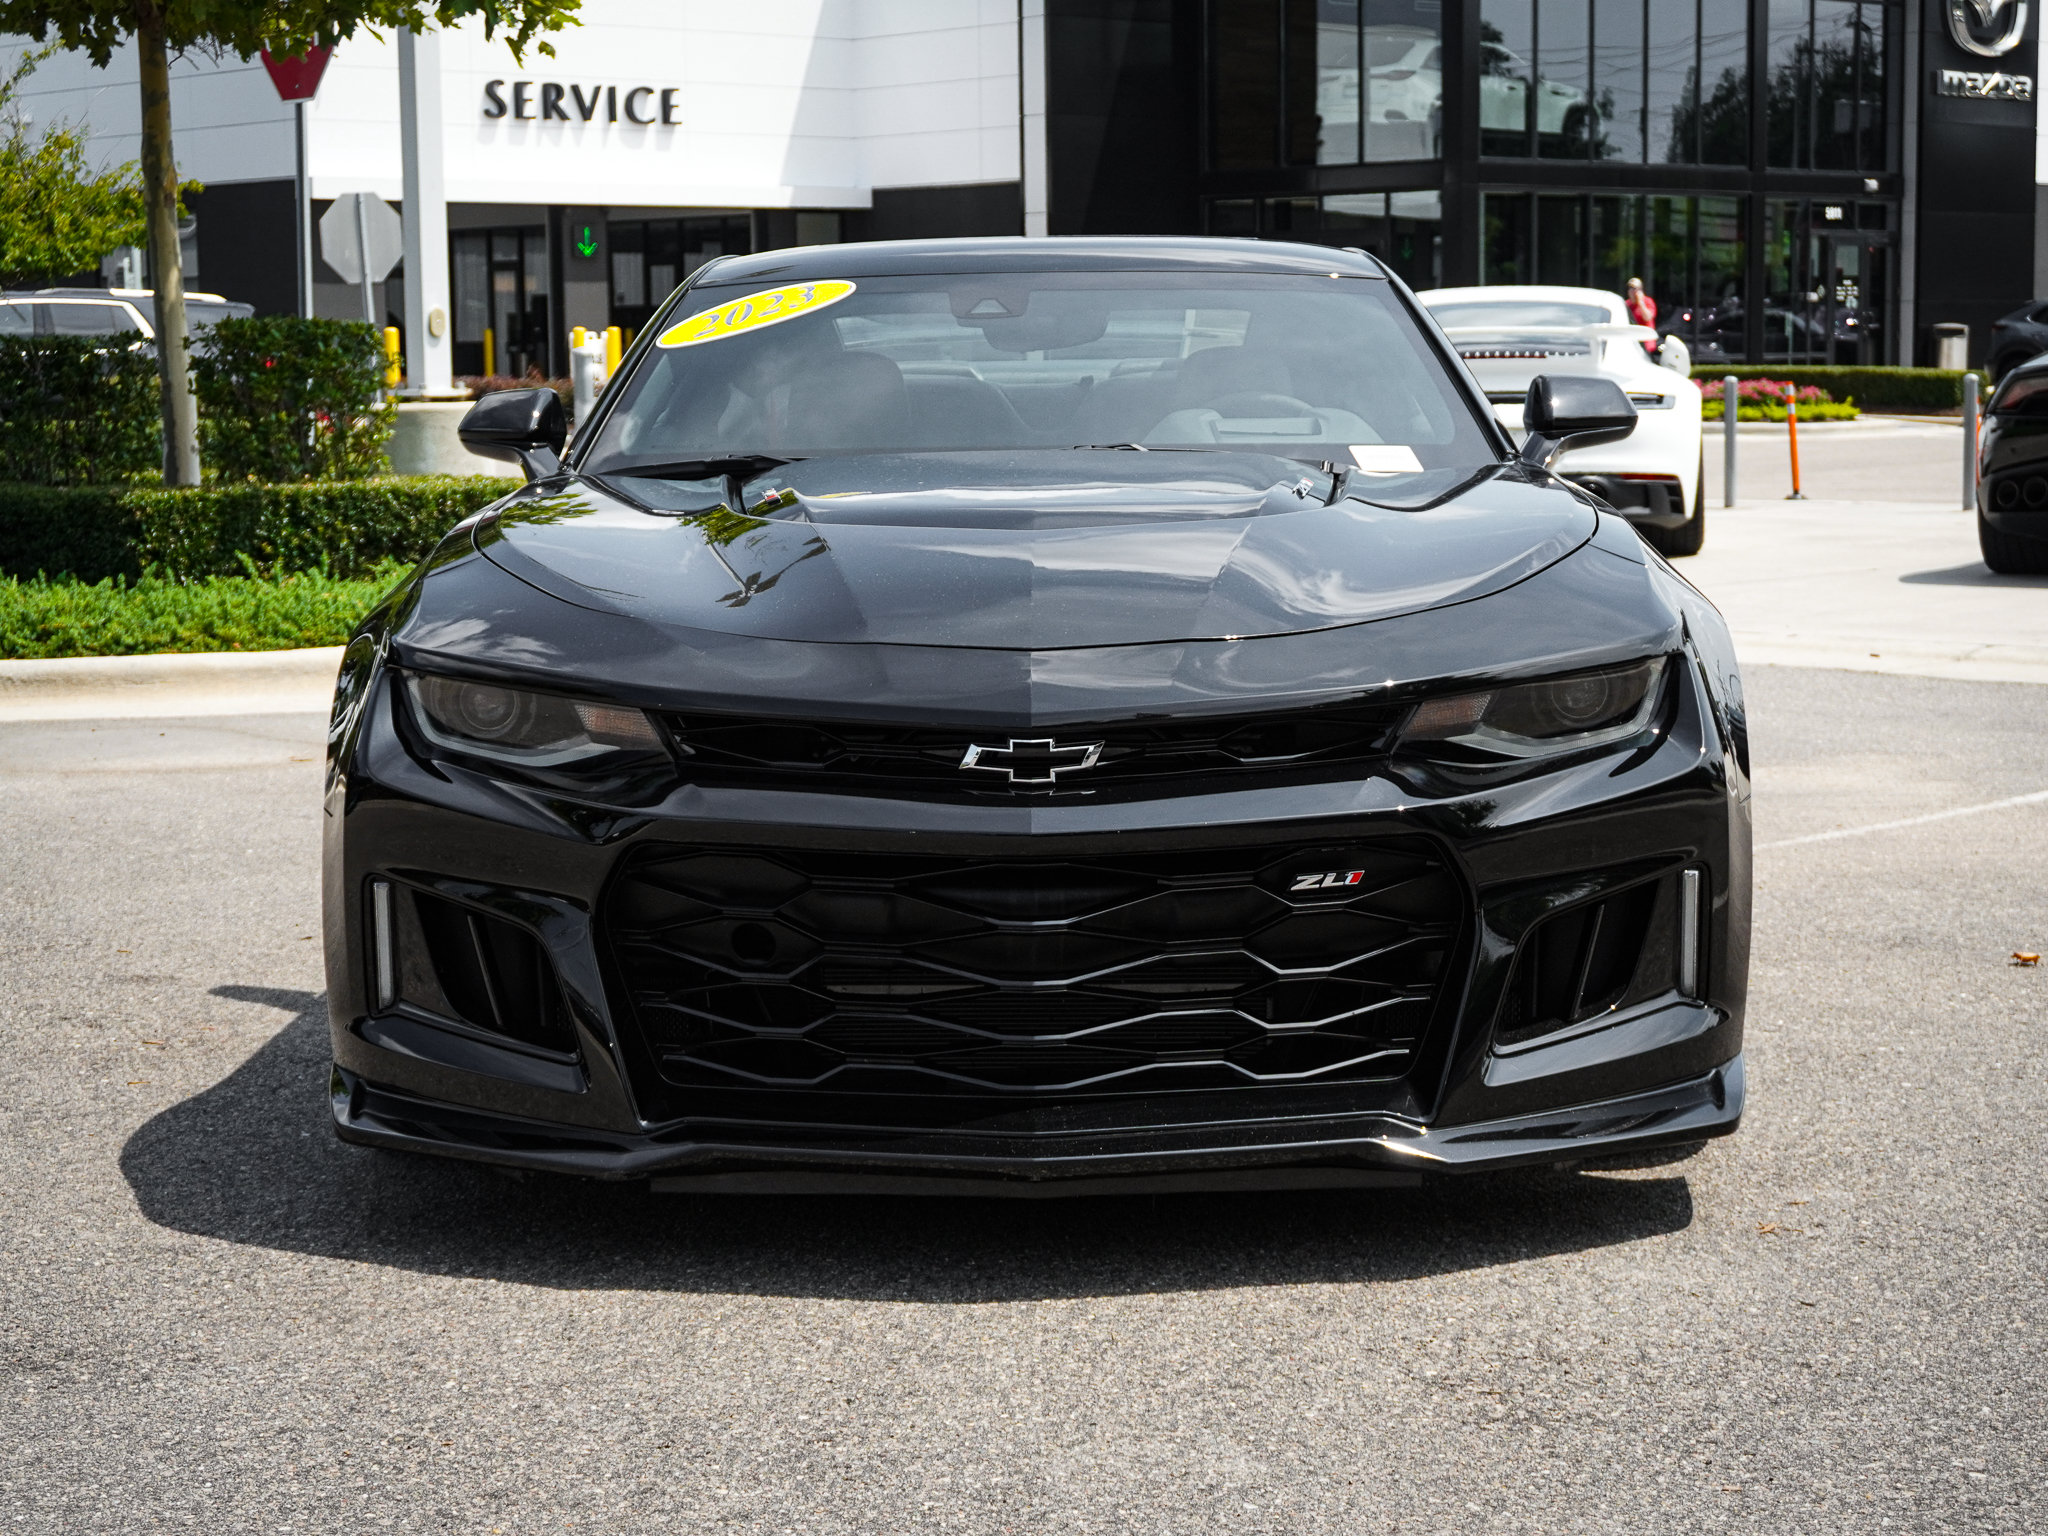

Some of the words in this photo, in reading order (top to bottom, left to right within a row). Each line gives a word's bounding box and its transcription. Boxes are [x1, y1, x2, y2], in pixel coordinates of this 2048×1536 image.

[483, 79, 683, 125] SERVICE
[693, 284, 816, 338] 2023
[1290, 870, 1366, 891] ZL1
